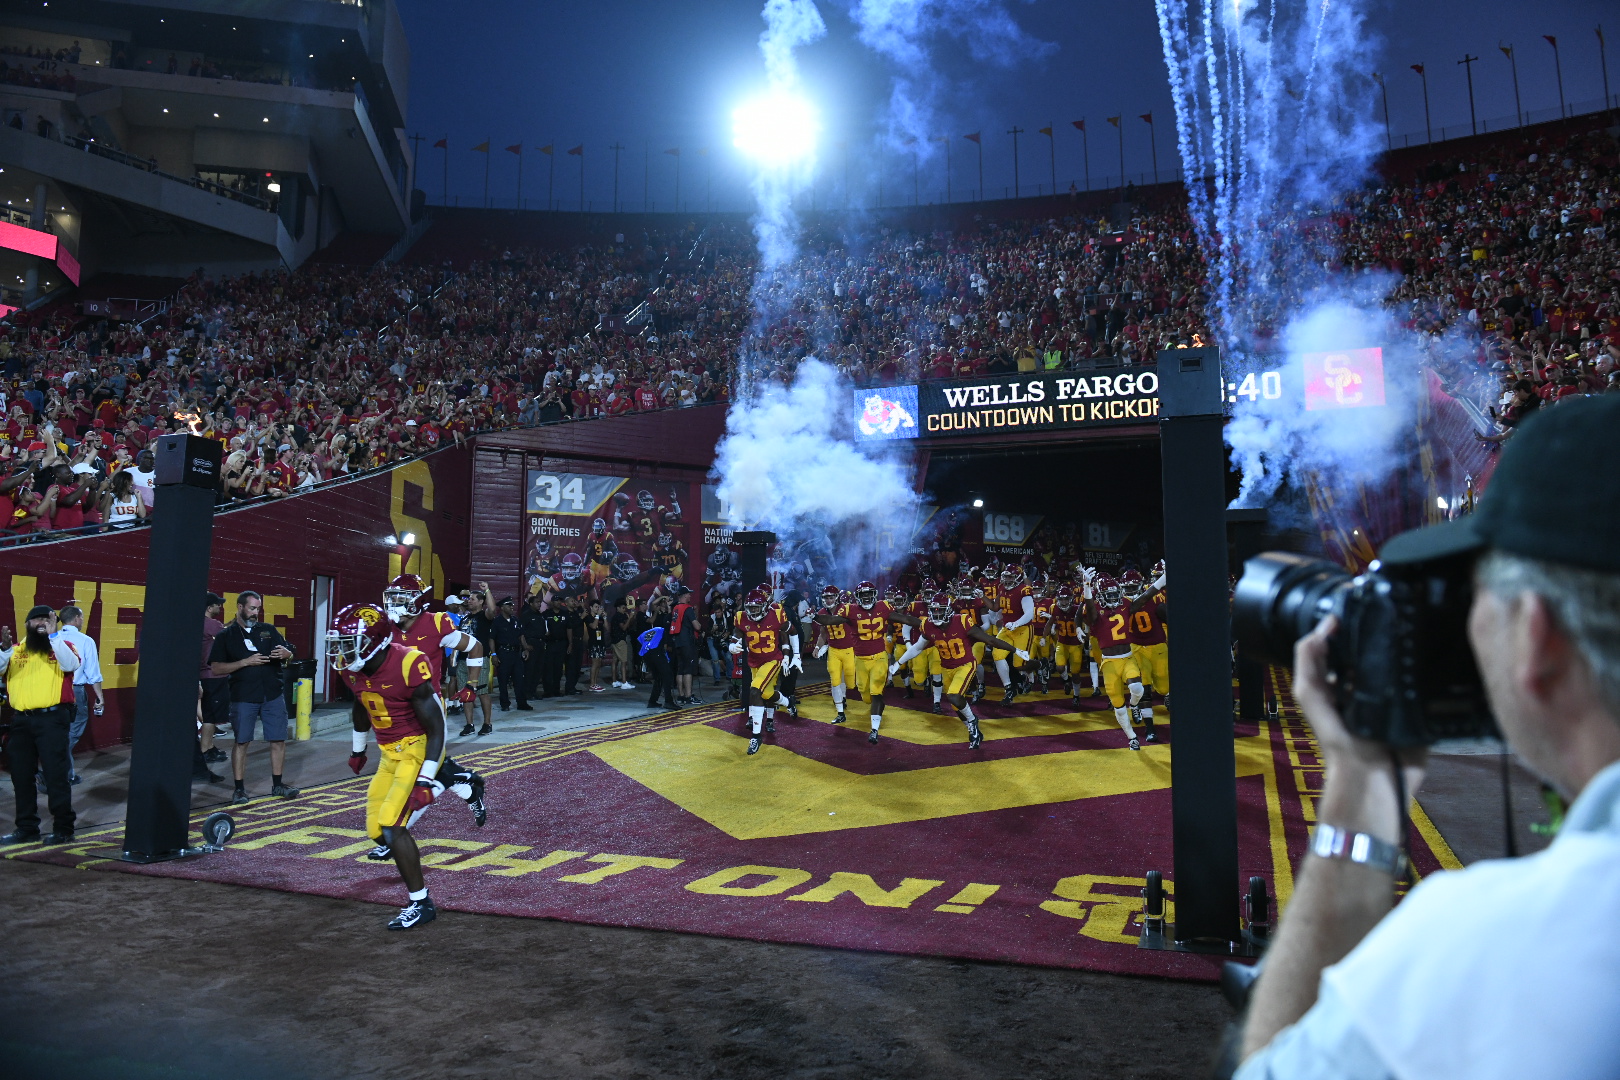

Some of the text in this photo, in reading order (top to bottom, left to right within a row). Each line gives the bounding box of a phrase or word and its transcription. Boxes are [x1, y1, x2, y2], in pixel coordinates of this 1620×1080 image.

[943, 371, 1158, 408] WELLS FARGO
[1221, 371, 1282, 403] :40
[927, 405, 1054, 432] COUNTDOWN
[1062, 403, 1086, 422] TO
[535, 474, 586, 510] 34
[531, 517, 559, 528] BOWL
[531, 526, 580, 537] VICTORIES
[984, 513, 1025, 541] 168
[1088, 522, 1111, 548] 81
[826, 623, 846, 640] 18
[857, 617, 884, 641] 52
[1108, 613, 1127, 641] 2
[746, 630, 776, 654] 23
[417, 661, 432, 680] 9
[361, 691, 393, 729] 9
[225, 825, 1002, 915] FIGHT ON!
